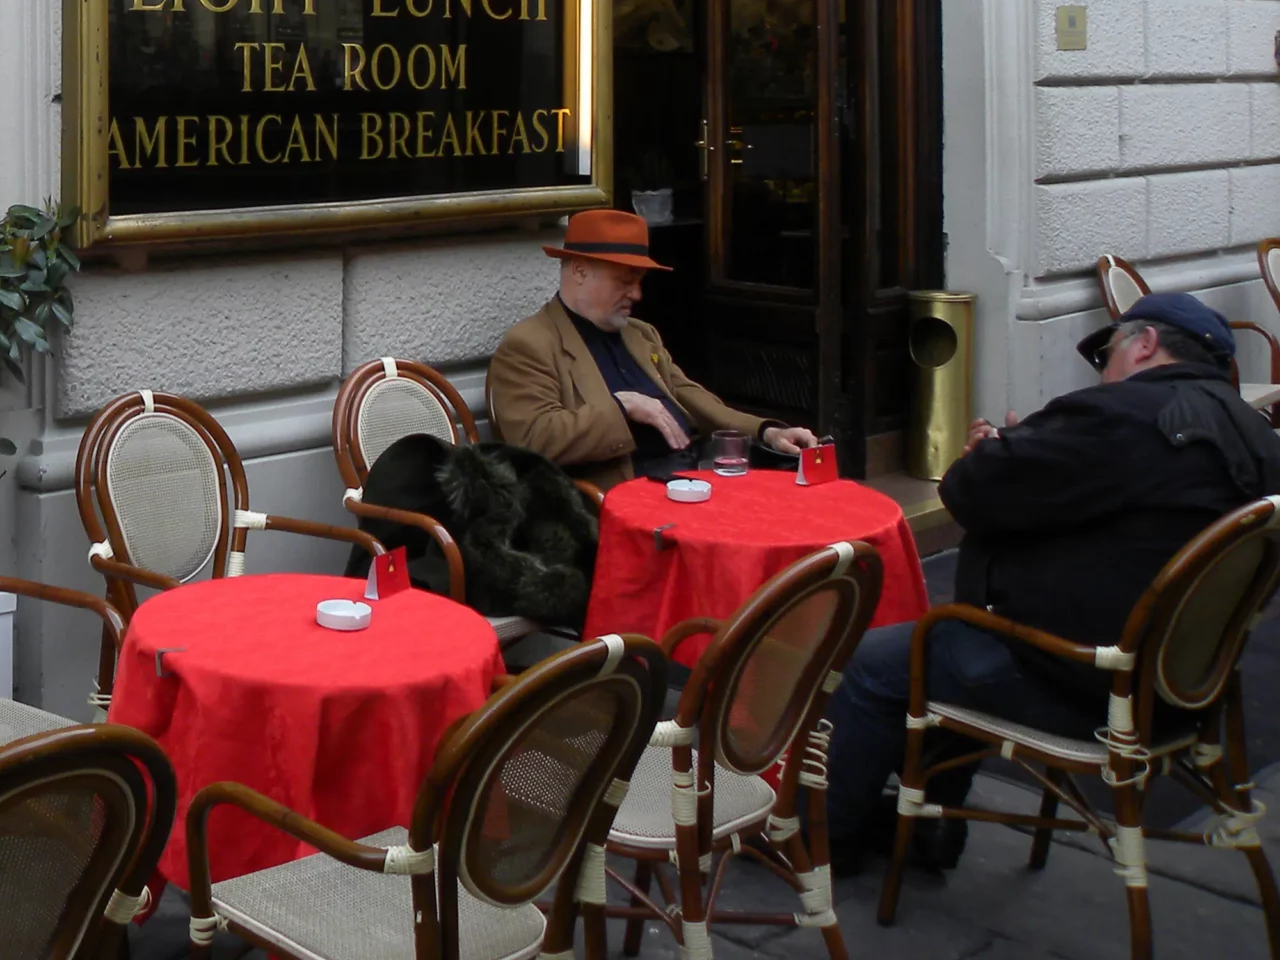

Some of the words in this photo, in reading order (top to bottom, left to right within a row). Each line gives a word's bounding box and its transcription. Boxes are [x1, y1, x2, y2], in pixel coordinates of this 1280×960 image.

[233, 42, 318, 93] TEA
[342, 42, 469, 92] ROOM
[108, 112, 340, 170] AMERICAN
[359, 107, 572, 161] BREAKFAST
